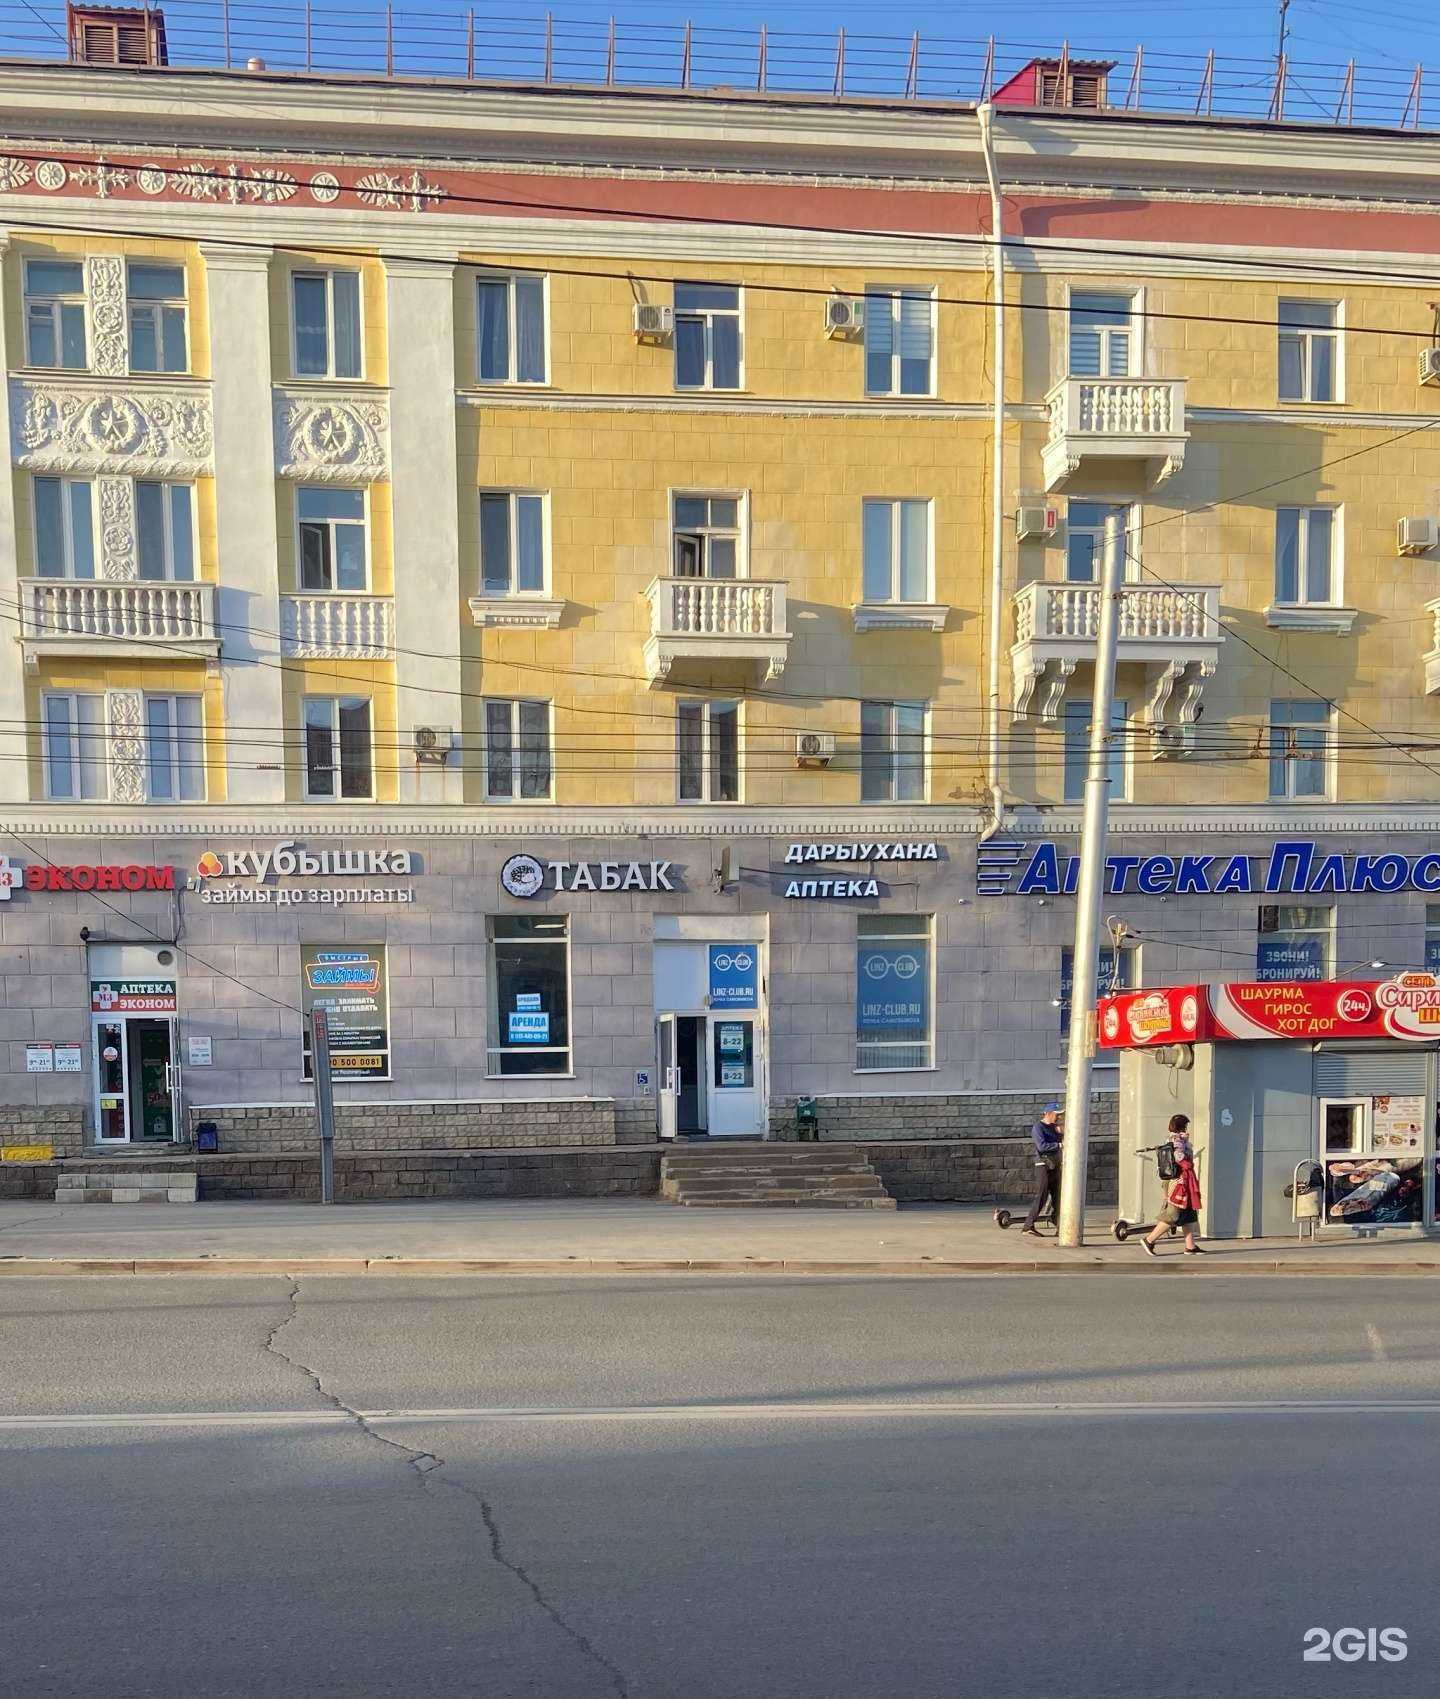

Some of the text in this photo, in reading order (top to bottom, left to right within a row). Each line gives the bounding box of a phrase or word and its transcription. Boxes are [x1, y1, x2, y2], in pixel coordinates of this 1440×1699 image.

[784, 843, 938, 863] ДАРЫУХАНА
[228, 841, 411, 884] кубышка
[26, 865, 175, 891] ЭКОНОМ
[548, 861, 674, 891] ТАБАК
[201, 883, 413, 907] займы до зарплаты
[784, 880, 879, 898] АПТЕКА
[1266, 951, 1309, 962] ЗВОНИ!
[313, 966, 375, 984] ЗАЙМЫ
[1256, 965, 1320, 979] БРОНИРУЙ!
[120, 984, 173, 994] АПТЕКА
[1240, 988, 1304, 1000] ШАУРМА
[120, 999, 175, 1009] ЭКОНОМ
[1265, 1003, 1312, 1015] ГИРОС
[512, 1016, 546, 1027] АРЕНДА
[1277, 1018, 1337, 1032] ХОТ ДОГ
[341, 1058, 356, 1066] 500
